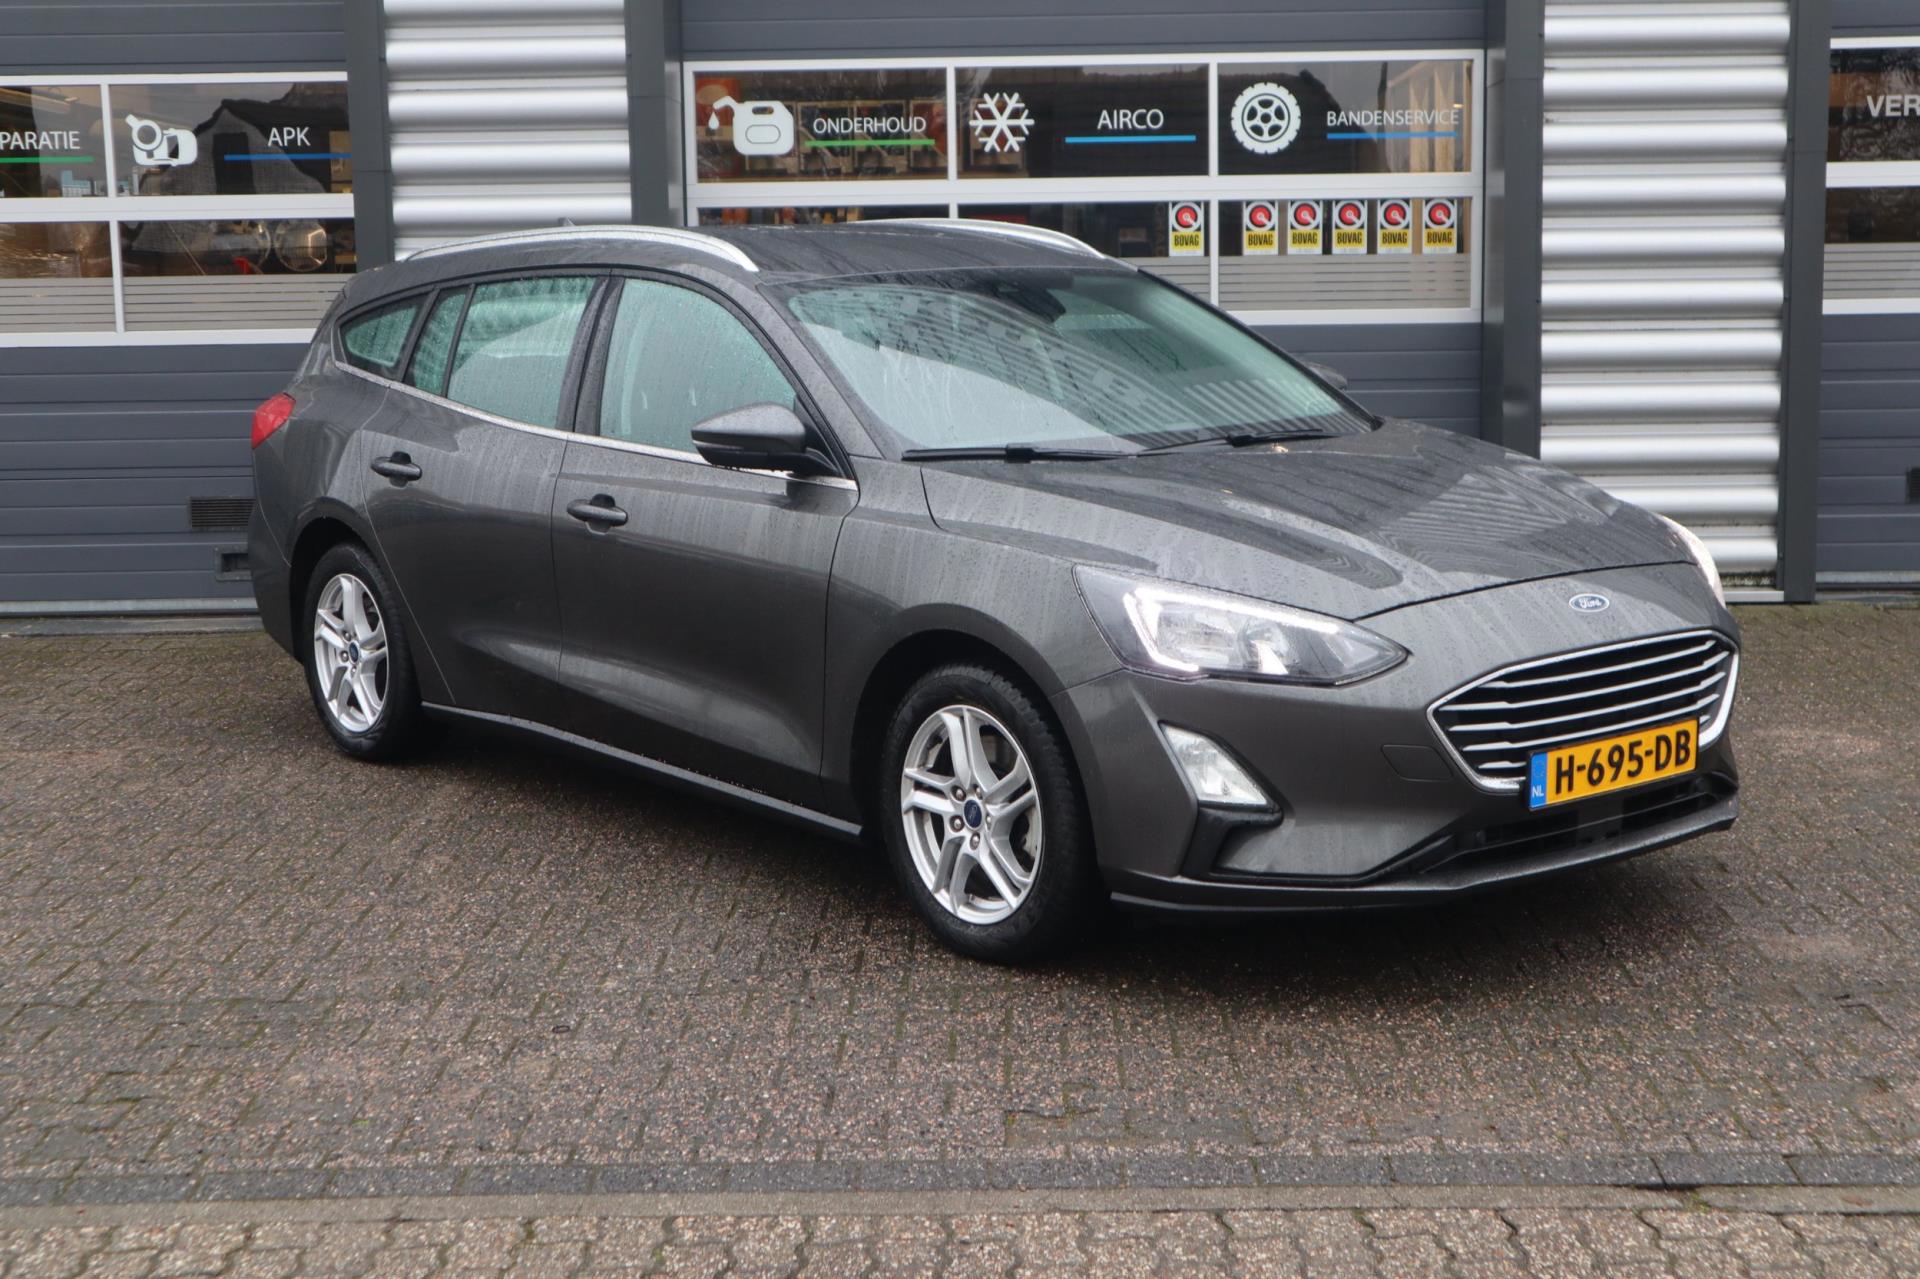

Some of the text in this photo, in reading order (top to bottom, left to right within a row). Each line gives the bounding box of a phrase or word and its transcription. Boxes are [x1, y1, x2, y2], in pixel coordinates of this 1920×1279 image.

[1866, 95, 1920, 117] VER
[813, 116, 927, 134] ONDERHOUD
[1097, 108, 1164, 130] AIRCO
[1326, 109, 1459, 127] BANDENSERVICE
[0, 130, 81, 150] PARATIE
[267, 127, 311, 147] APK
[1174, 234, 1200, 246] BOVAG
[1248, 233, 1274, 246] BOVAG
[1292, 231, 1318, 244] BOVAG
[1337, 231, 1362, 244] BOVAG
[1382, 231, 1408, 244] BOVAG
[1427, 231, 1453, 244] BOVAG
[1555, 729, 1691, 795] H-695-DB
[1532, 785, 1544, 798] NL
